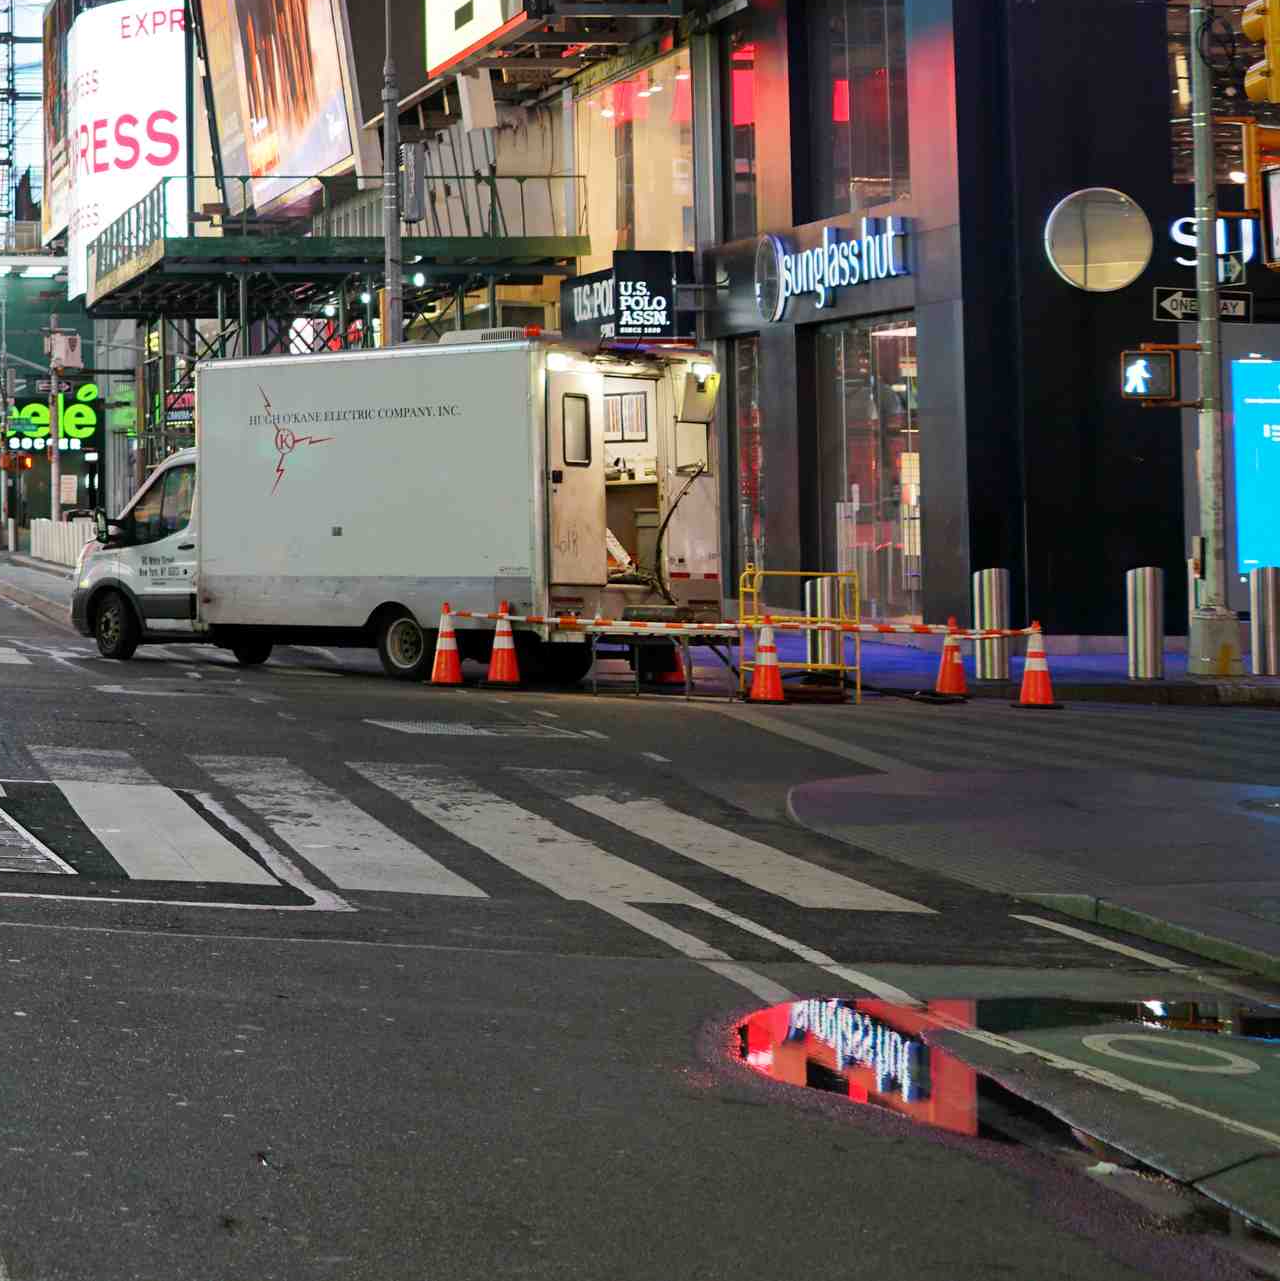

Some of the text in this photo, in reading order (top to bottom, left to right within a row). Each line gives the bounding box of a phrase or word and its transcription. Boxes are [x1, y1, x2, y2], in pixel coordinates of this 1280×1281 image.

[120, 8, 185, 39] EXPR
[783, 215, 897, 309] sunglass hut
[619, 281, 651, 296] U.S.
[619, 296, 667, 311] POLO
[1170, 297, 1199, 313] ONE
[619, 310, 670, 326] ASSN.
[323, 409, 376, 422] ELECTRIC
[438, 405, 463, 417] INC.
